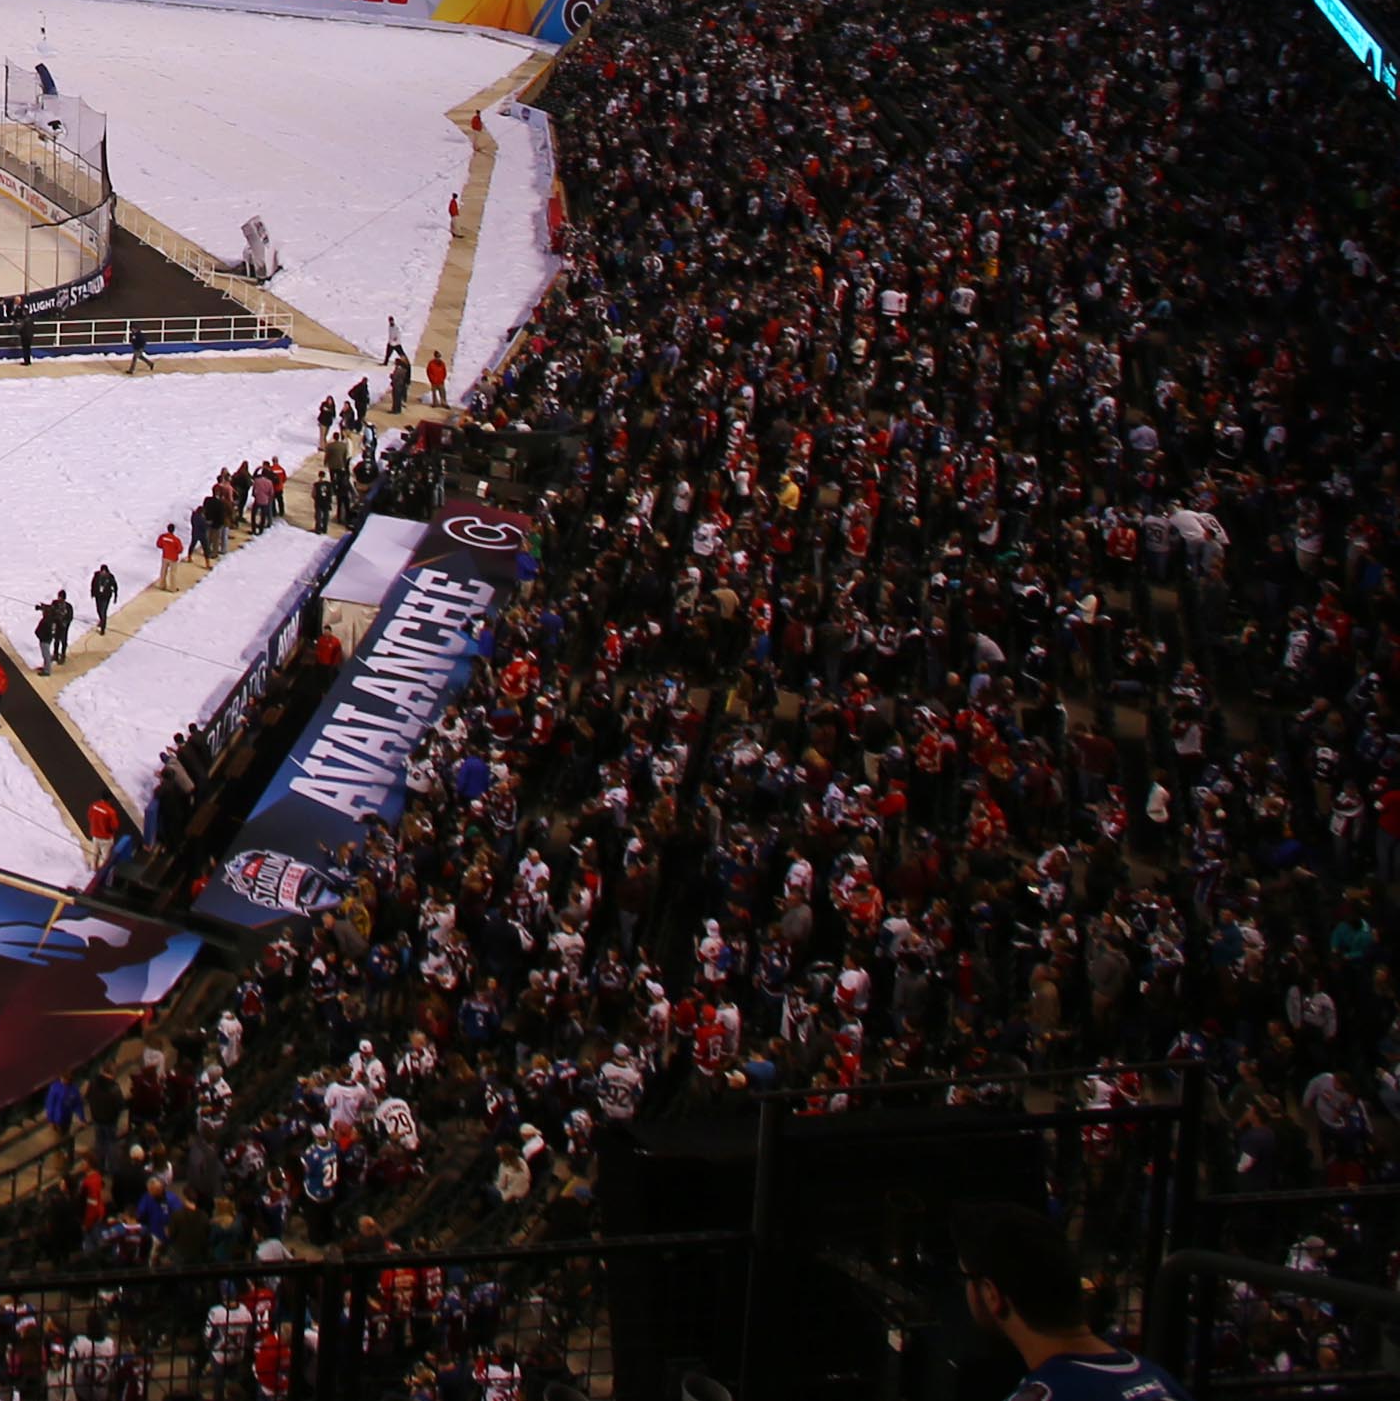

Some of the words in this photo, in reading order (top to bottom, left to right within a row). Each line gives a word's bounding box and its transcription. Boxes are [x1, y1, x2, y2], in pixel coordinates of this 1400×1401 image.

[30, 297, 56, 314] LIGHT
[289, 567, 496, 822] AVALANCHE
[255, 851, 289, 908] STADIUM
[283, 866, 304, 901] SERIES
[389, 1109, 413, 1135] 29
[322, 1160, 338, 1188] 21
